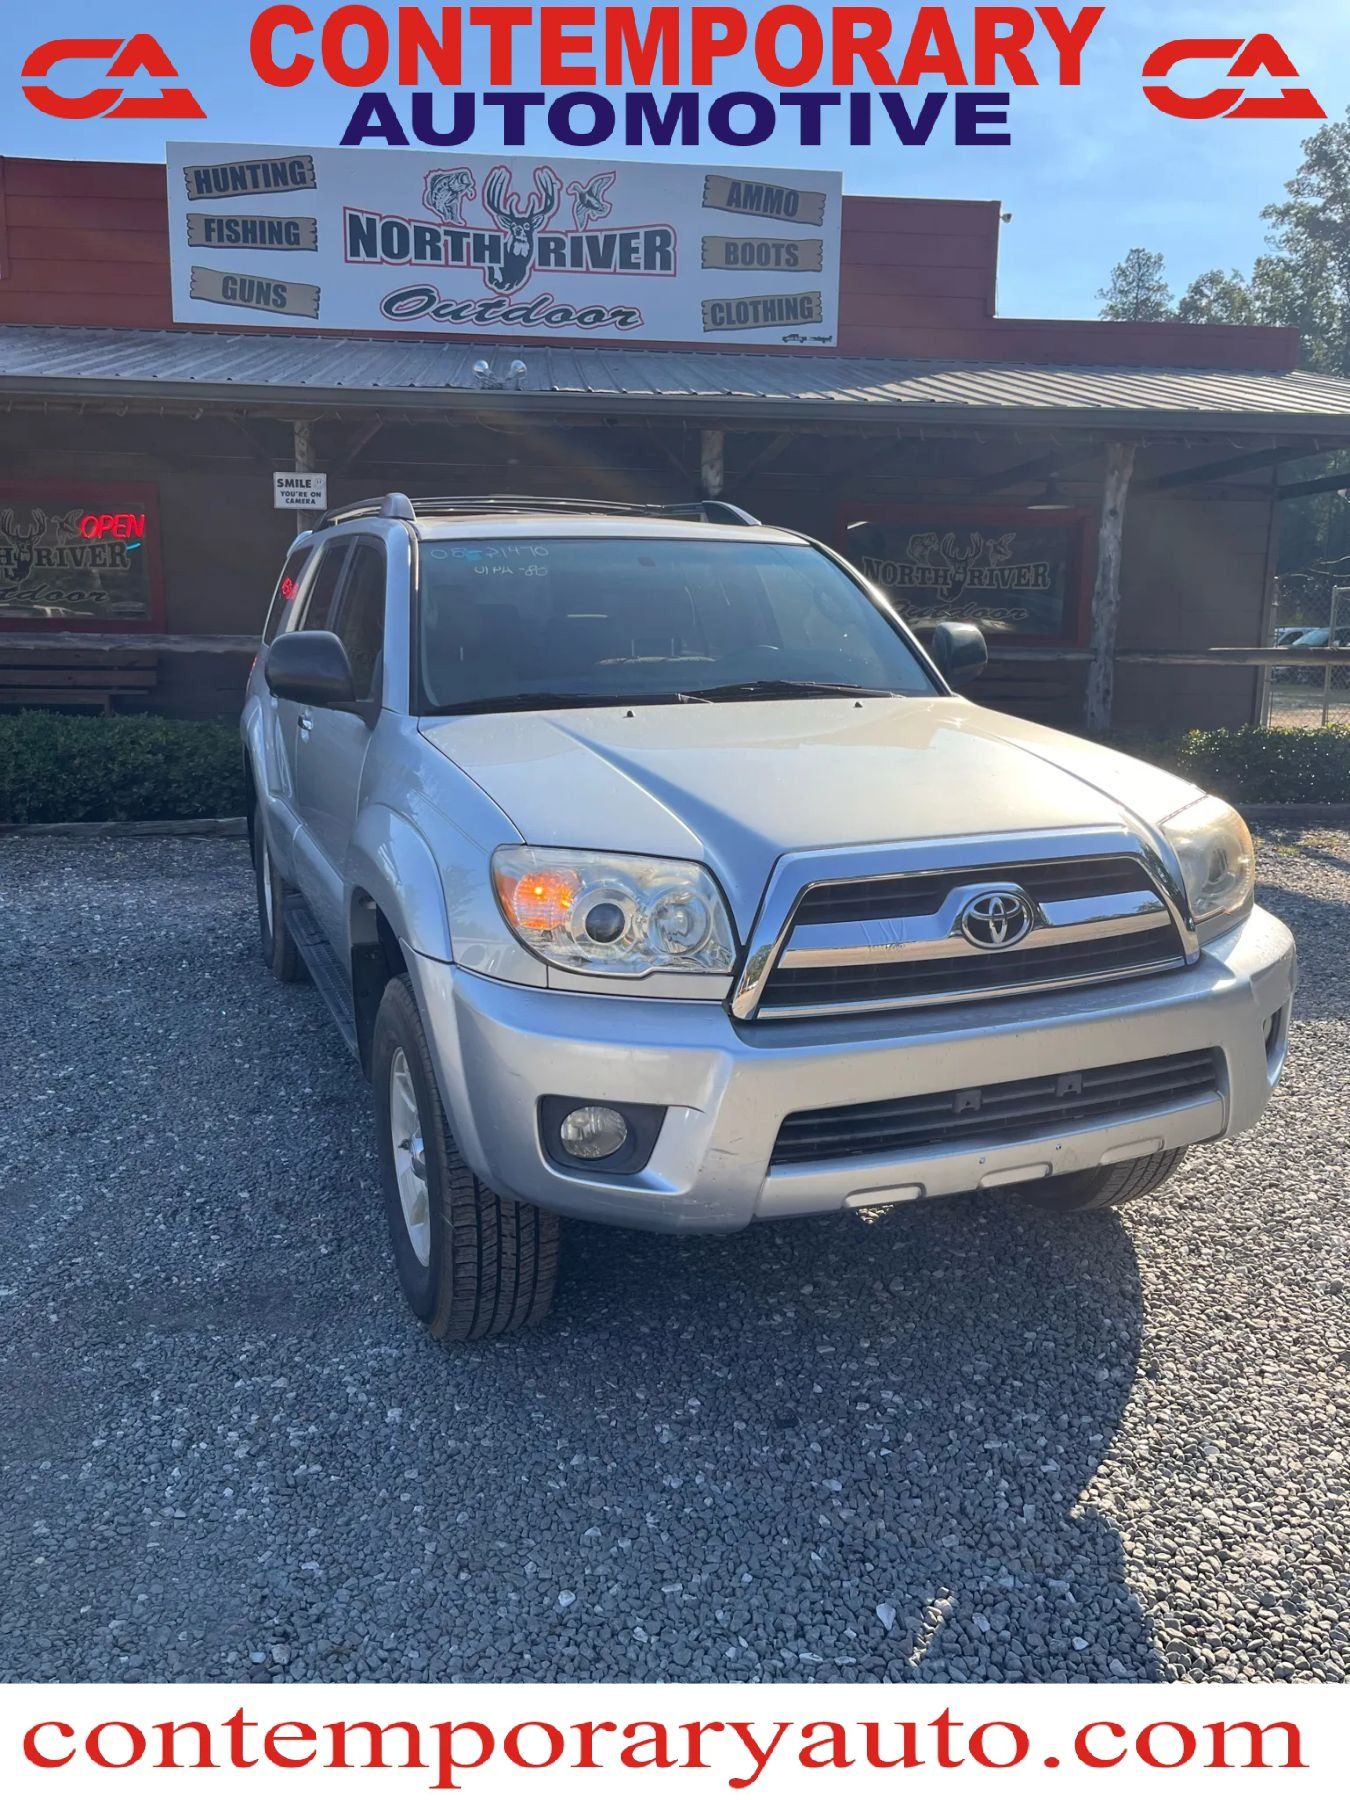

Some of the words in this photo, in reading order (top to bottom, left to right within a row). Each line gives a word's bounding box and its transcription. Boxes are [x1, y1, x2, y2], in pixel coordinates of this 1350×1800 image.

[193, 160, 307, 195] HUNTING
[726, 181, 800, 218] AMMO
[204, 218, 300, 246] FISHING
[348, 213, 504, 263] NORTH
[537, 229, 673, 272] RIVER
[724, 241, 799, 267] BOOTS
[221, 275, 287, 309] GUNS
[382, 287, 641, 328] Outdoor
[710, 296, 814, 327] CLOTHING
[277, 478, 312, 489] SMILE
[80, 513, 146, 539] OPEN
[34, 543, 129, 568] RIVER
[863, 557, 950, 588] NORTH
[966, 563, 1049, 588] RIVER
